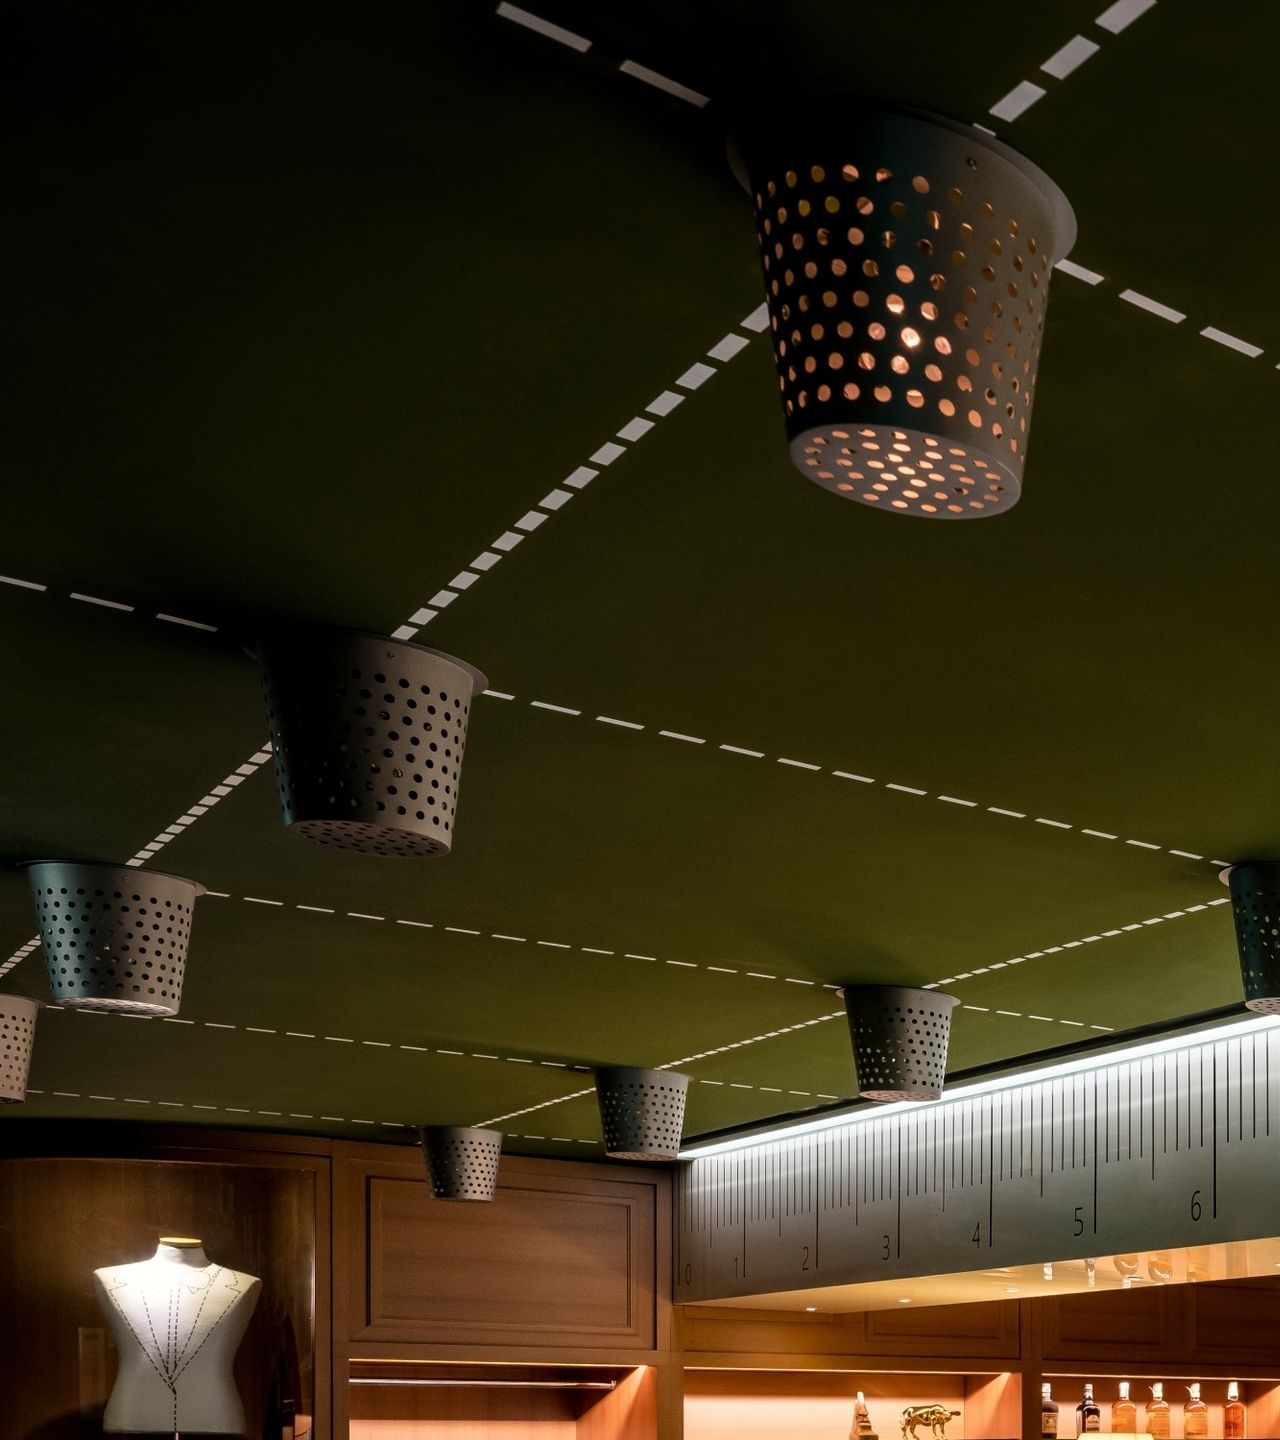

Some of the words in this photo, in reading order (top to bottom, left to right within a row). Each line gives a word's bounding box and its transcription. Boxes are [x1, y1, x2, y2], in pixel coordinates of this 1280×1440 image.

[1190, 1190, 1202, 1222] 6
[971, 1222, 981, 1249] 4
[1073, 1207, 1084, 1237] 5
[801, 1246, 809, 1271] 2
[881, 1234, 890, 1261] 3
[684, 1262, 692, 1289] 0
[734, 1256, 740, 1280] 1
